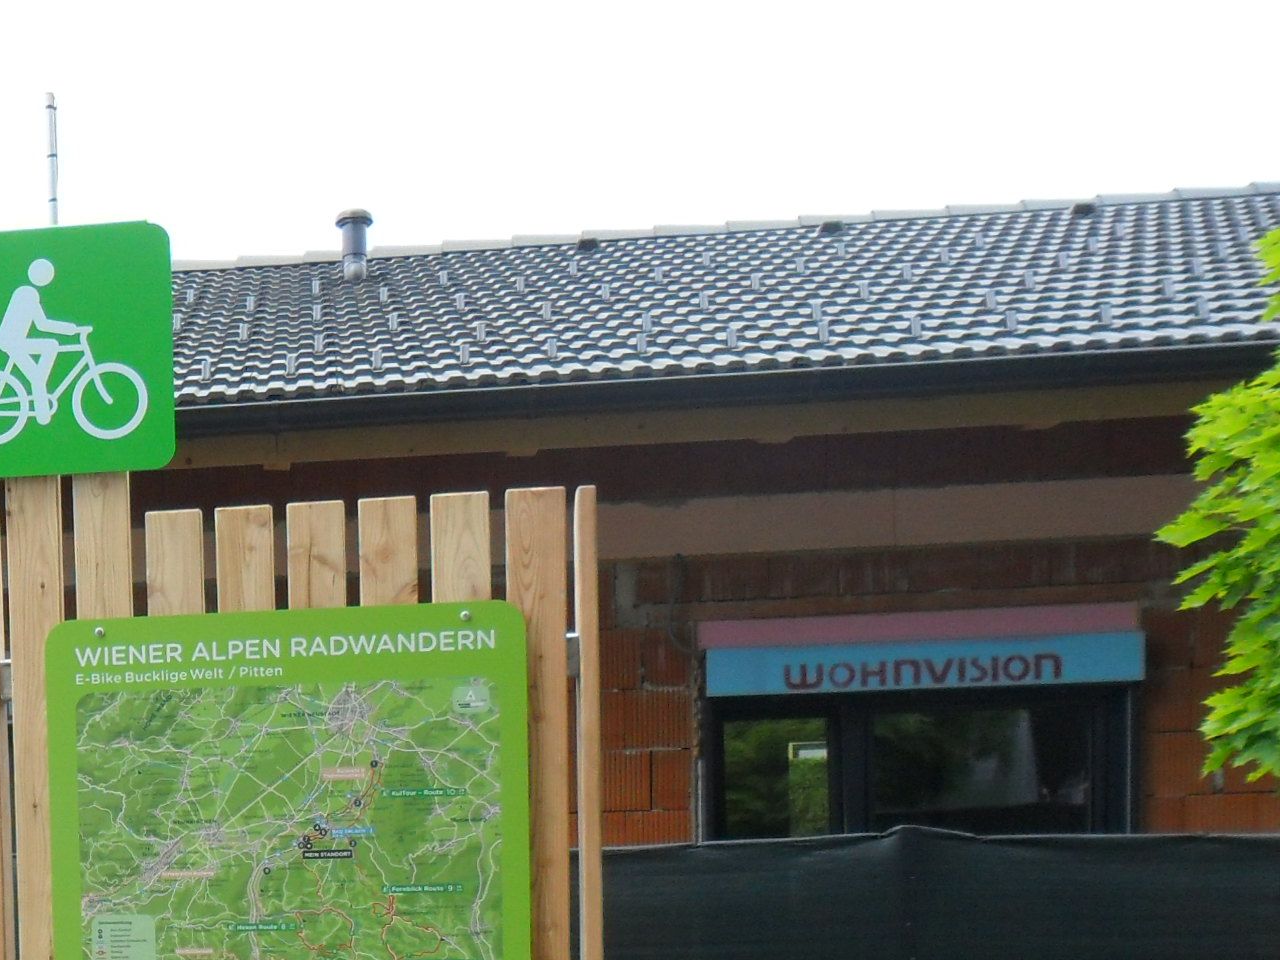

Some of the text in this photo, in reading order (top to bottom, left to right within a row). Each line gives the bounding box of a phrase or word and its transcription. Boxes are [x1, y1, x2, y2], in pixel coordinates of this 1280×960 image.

[75, 630, 496, 668] WIENER ALPEN RADWANDERN
[75, 672, 121, 686] E-Bike
[125, 668, 188, 684] Bucklige
[189, 667, 224, 681] Welt
[239, 664, 283, 679] Pitten
